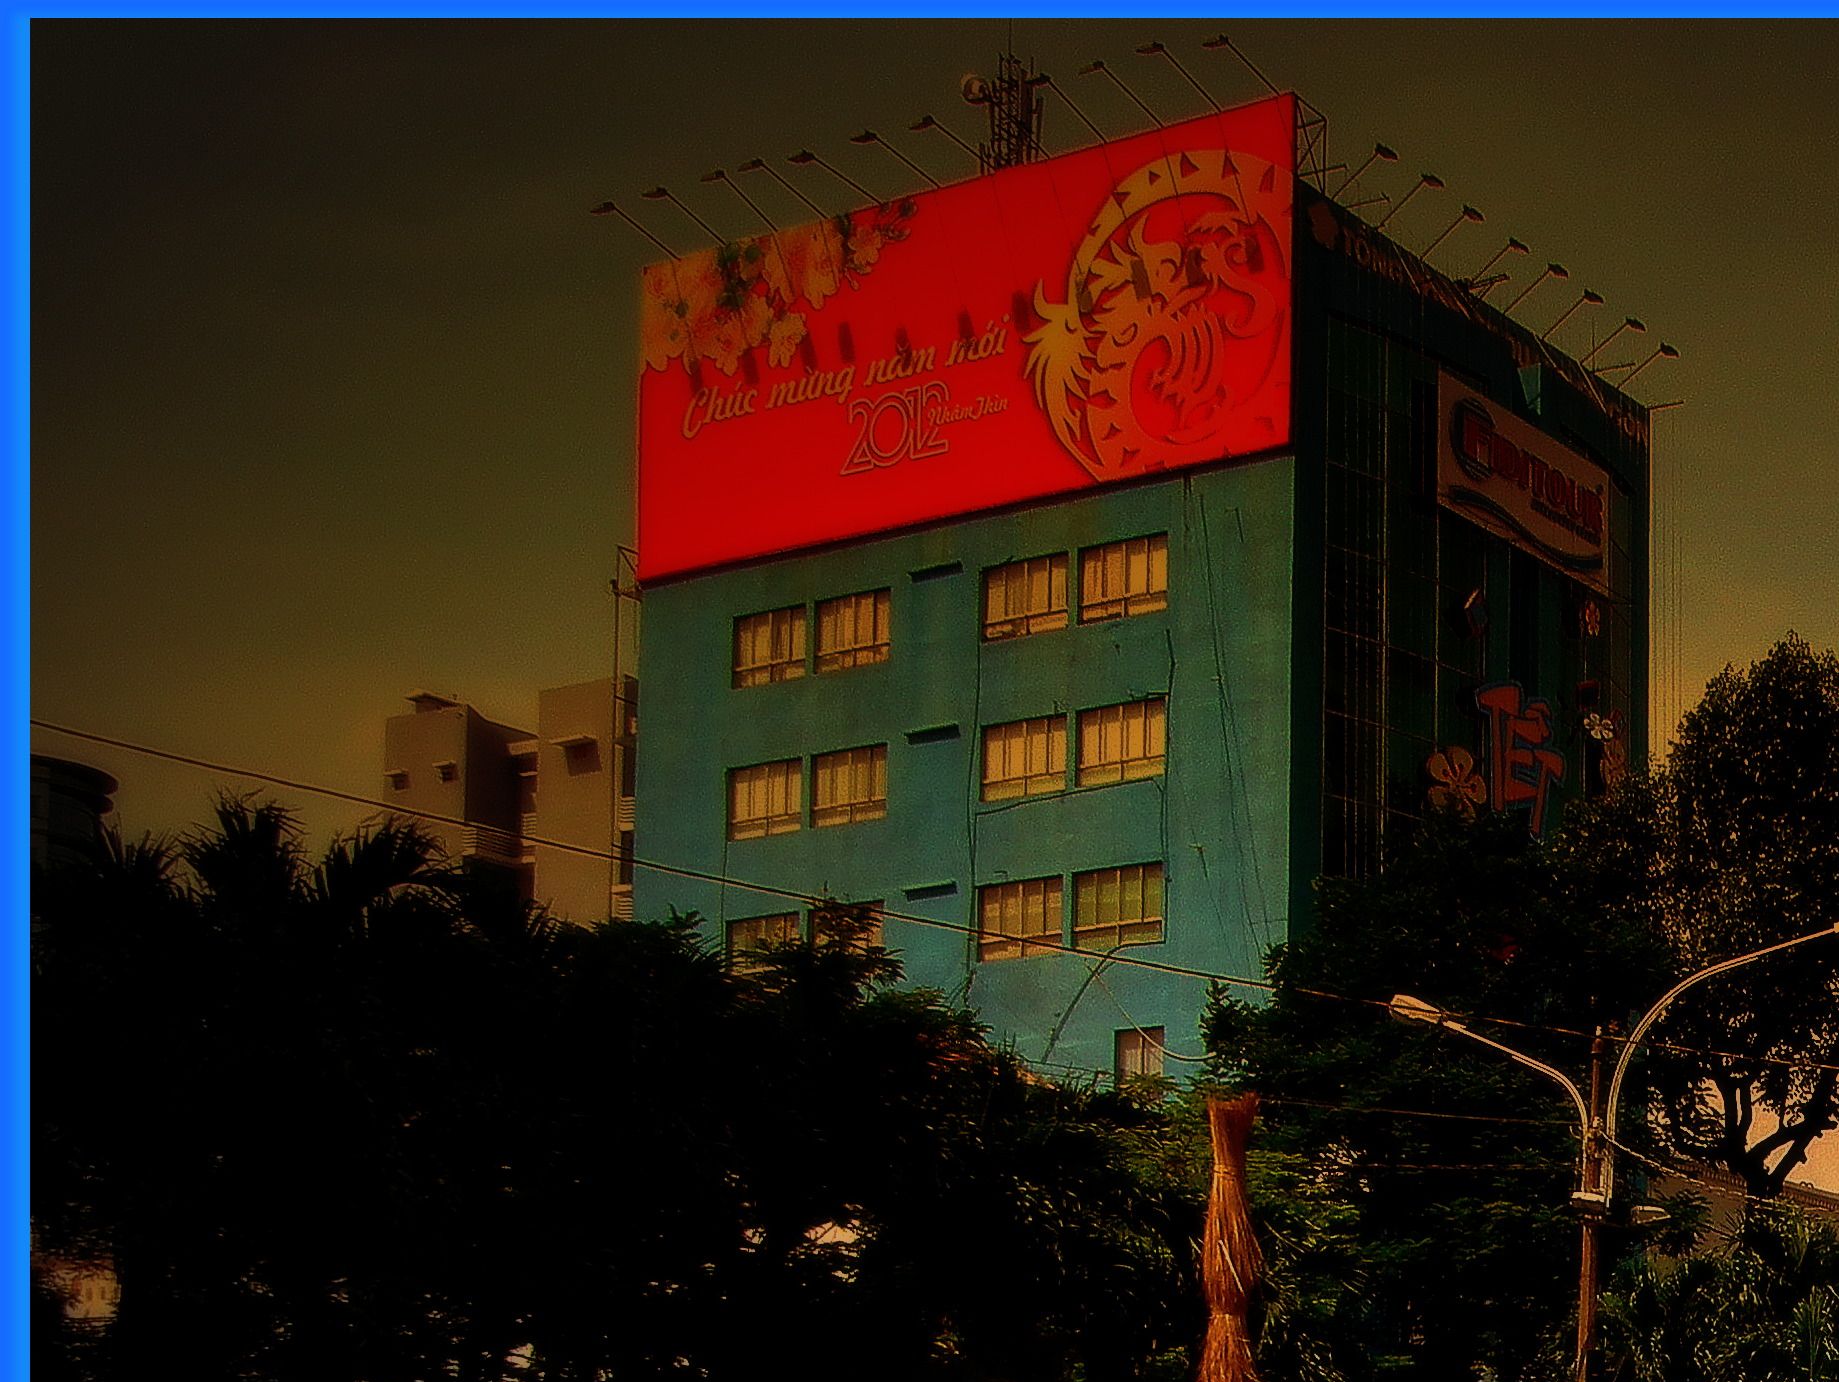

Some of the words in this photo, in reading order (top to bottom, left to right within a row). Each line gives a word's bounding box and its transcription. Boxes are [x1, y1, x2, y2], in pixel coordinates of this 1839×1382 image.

[680, 380, 757, 440] Chúc
[945, 313, 1010, 367] mới
[840, 380, 949, 475] 2012
